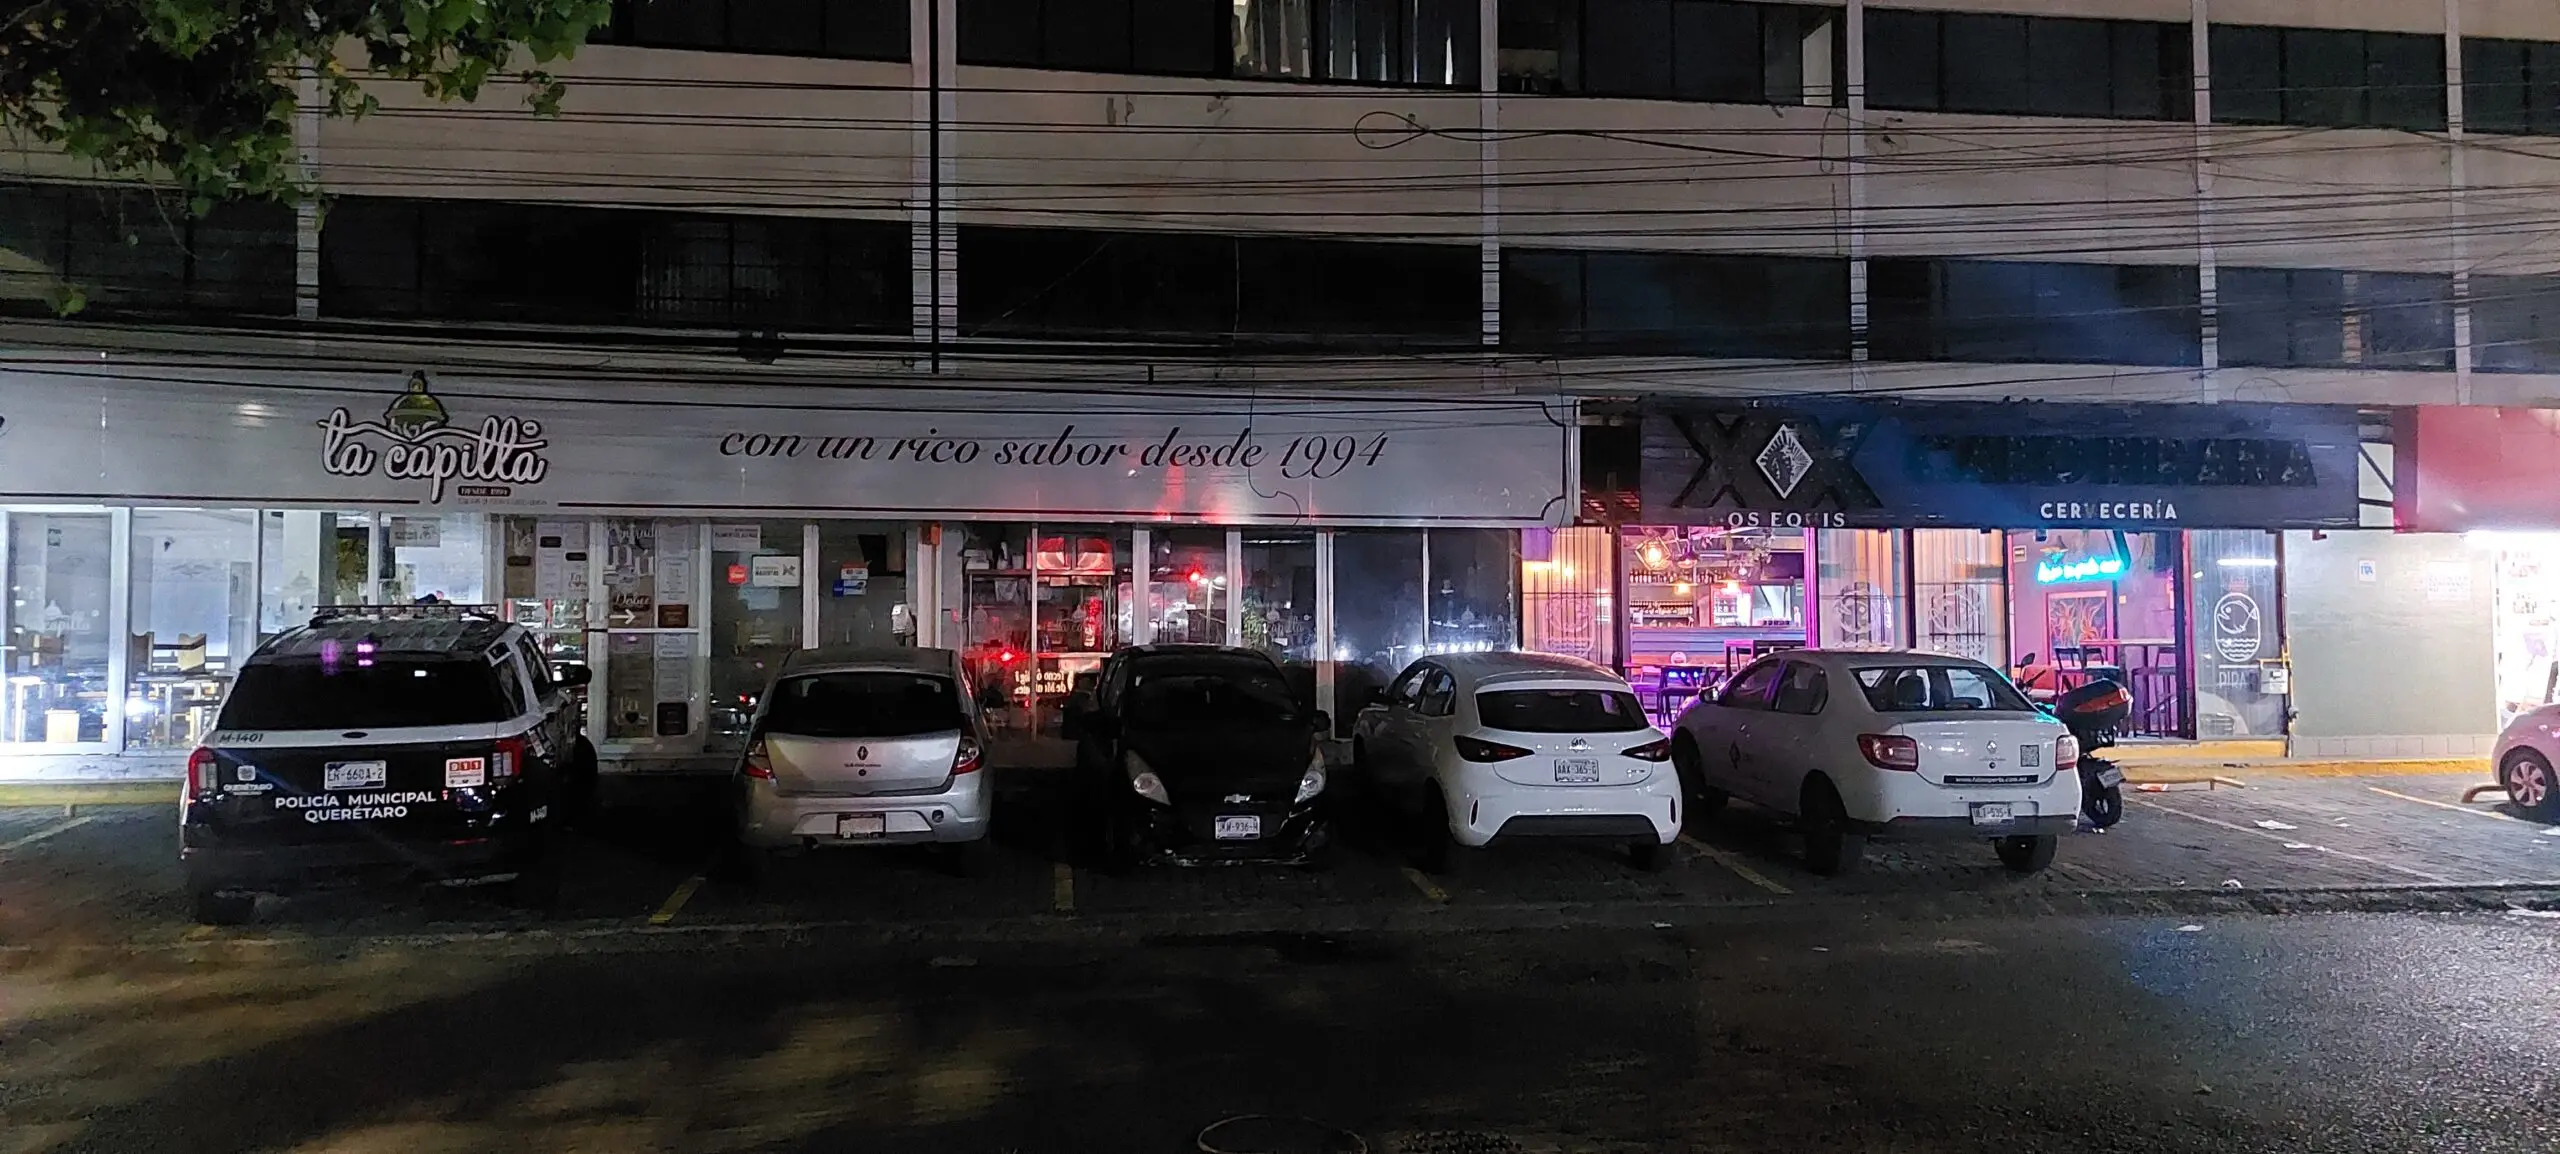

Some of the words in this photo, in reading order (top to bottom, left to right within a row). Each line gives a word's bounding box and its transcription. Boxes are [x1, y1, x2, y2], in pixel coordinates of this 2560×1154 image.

[316, 406, 377, 476] la
[382, 414, 548, 505] capilla
[719, 432, 808, 458] con
[816, 436, 883, 461] un
[888, 427, 985, 465] rico
[994, 424, 1129, 467] sabor
[1140, 426, 1268, 468] desde
[1279, 431, 1390, 480] 1994
[2040, 497, 2178, 520] CERVECERÍA
[220, 733, 263, 743] M-1401
[451, 761, 480, 771] 911
[275, 793, 340, 809] POLICÍA
[348, 791, 437, 806] MUNICIPAL
[304, 805, 408, 824] QUERÉTARO
